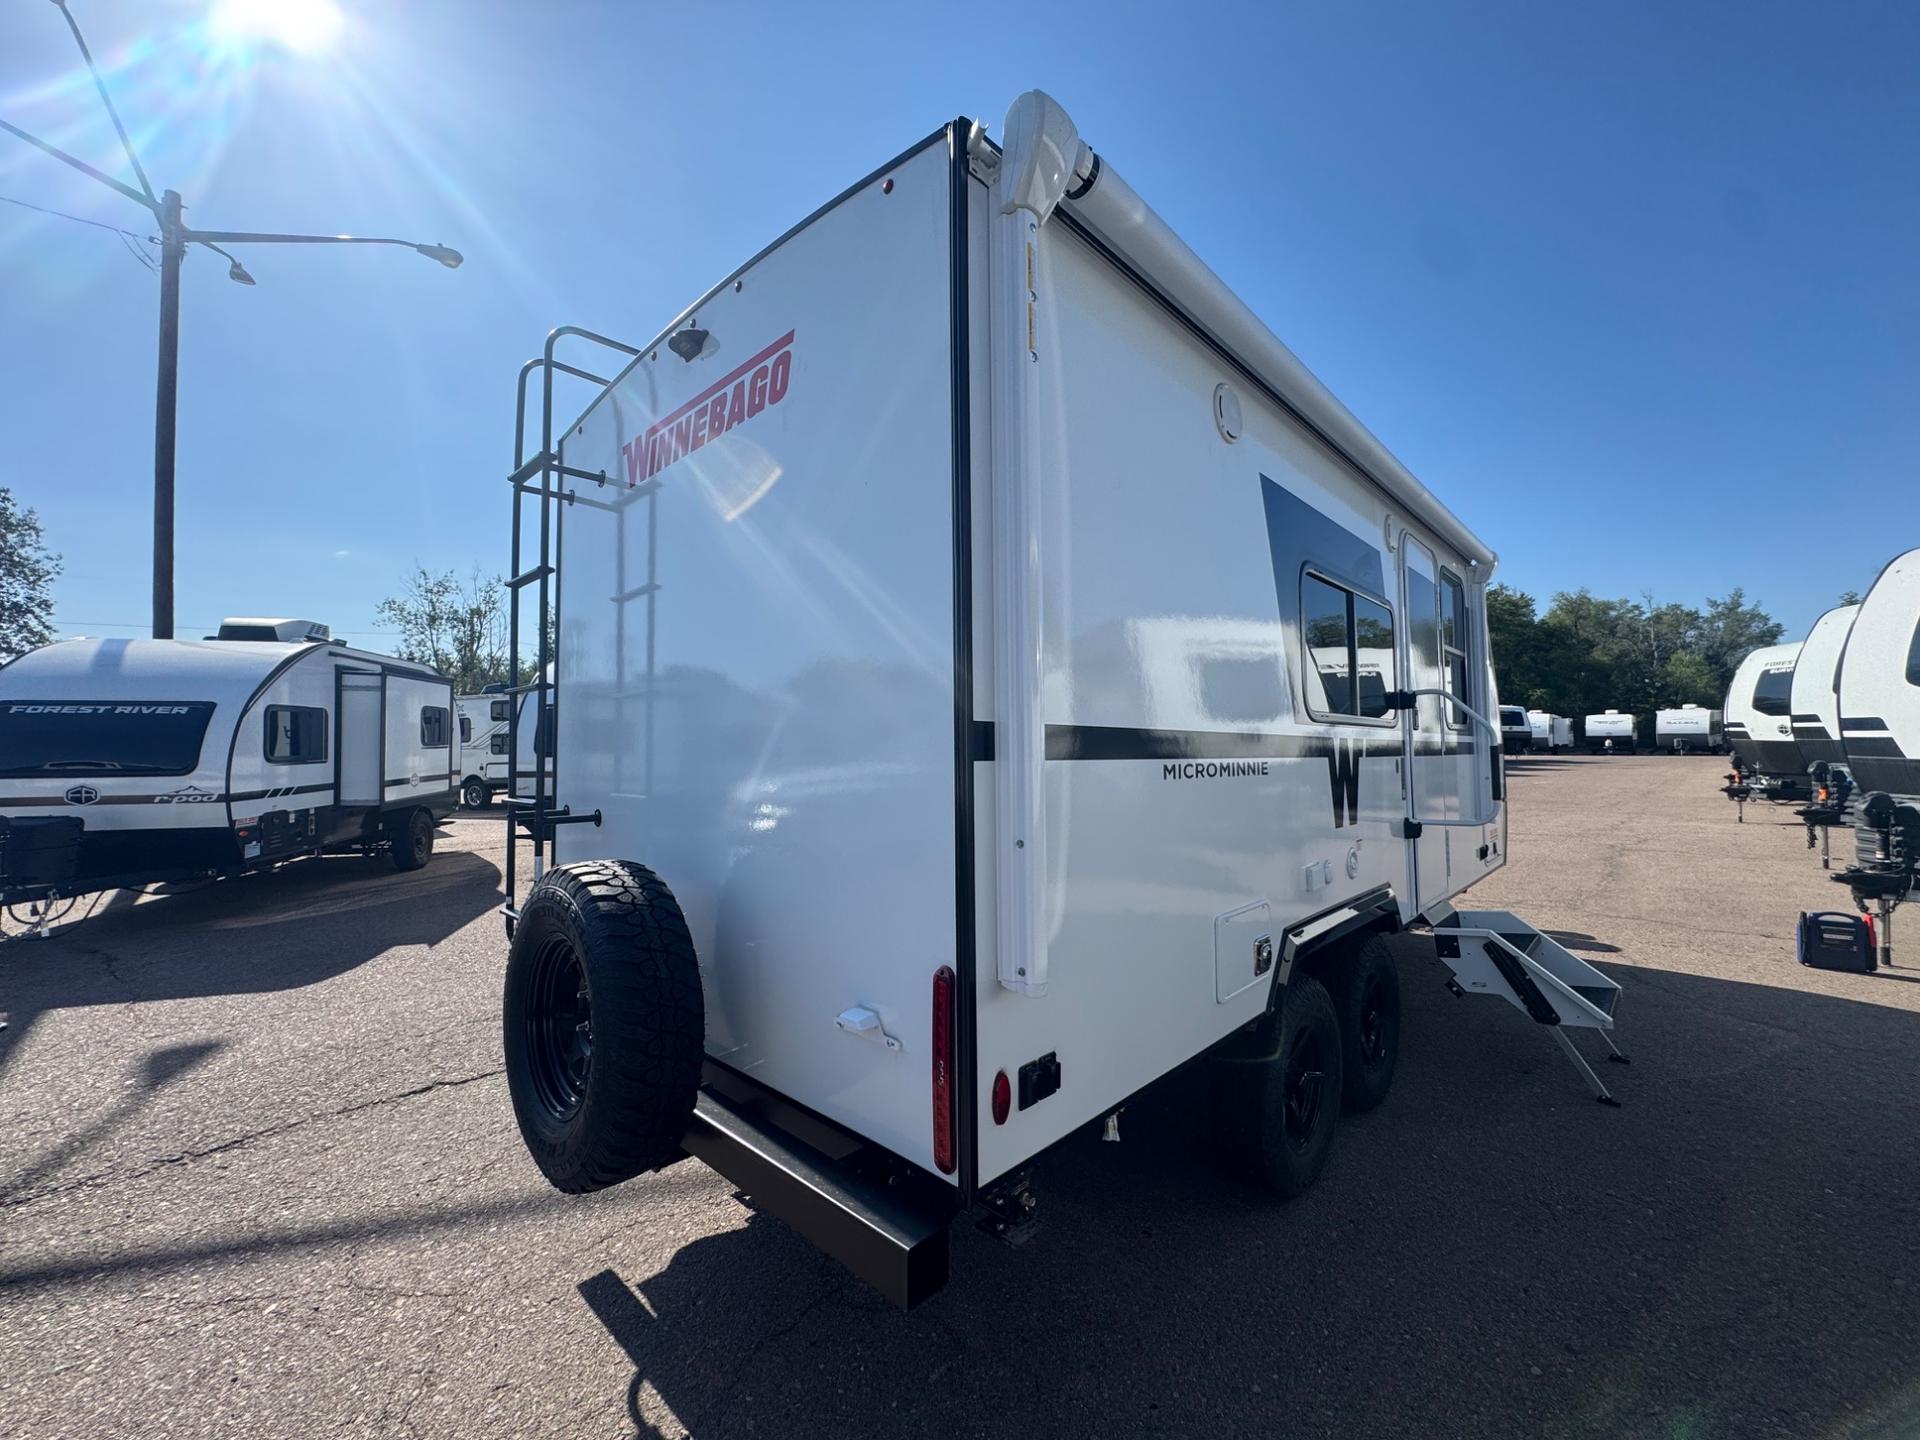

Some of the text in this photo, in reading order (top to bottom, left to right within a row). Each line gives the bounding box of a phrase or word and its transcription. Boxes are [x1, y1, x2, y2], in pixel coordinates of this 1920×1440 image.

[623, 329, 795, 488] WINNEBAGO
[8, 705, 189, 714] FOREST RIVER
[1163, 761, 1269, 780] MICROMINNIE
